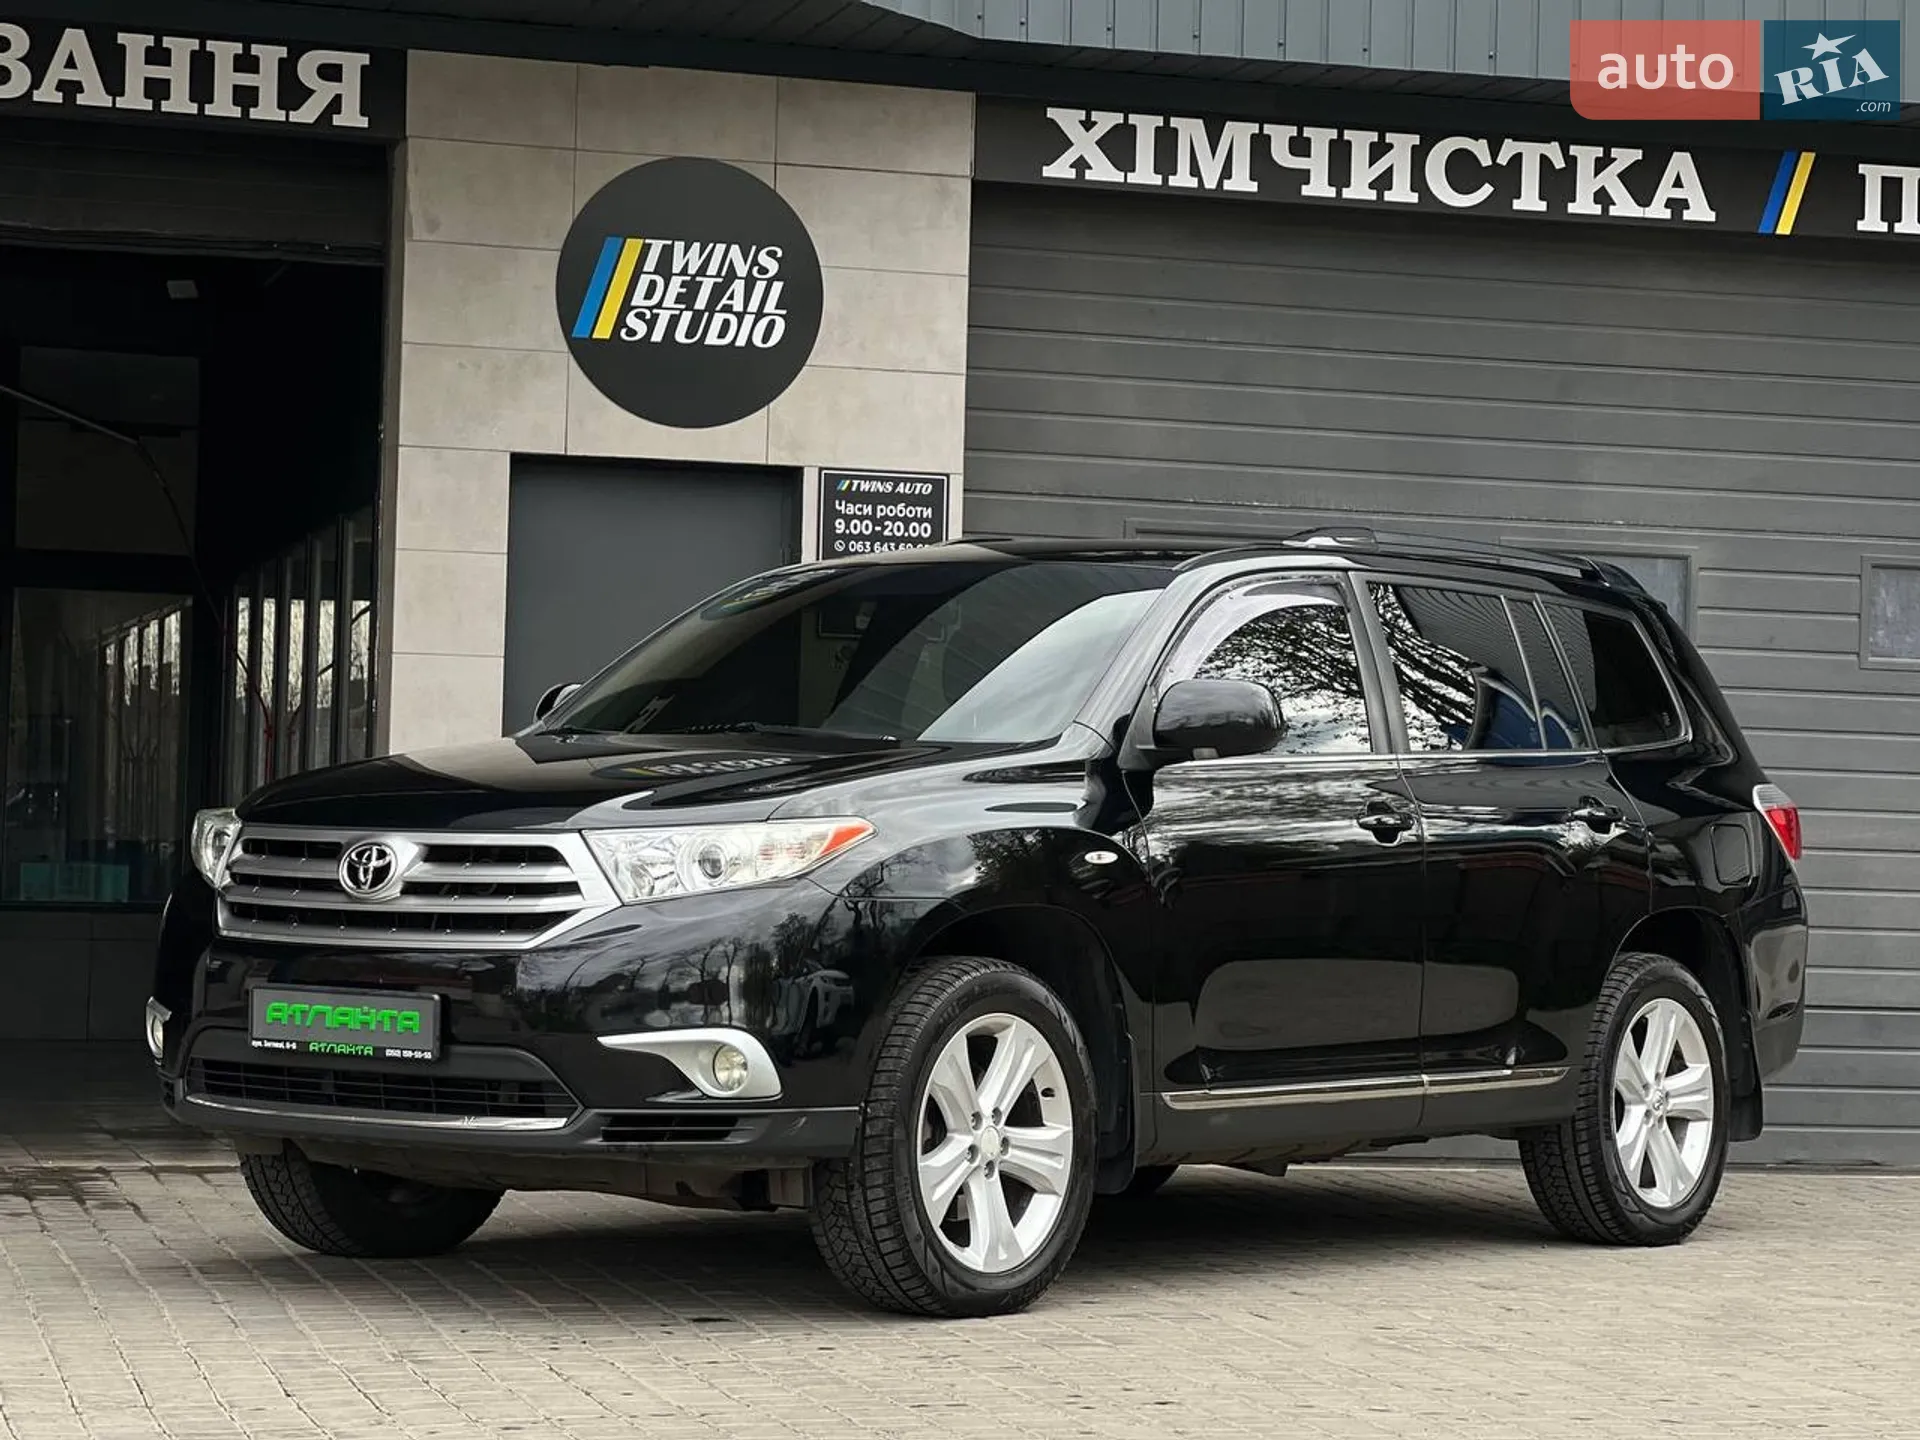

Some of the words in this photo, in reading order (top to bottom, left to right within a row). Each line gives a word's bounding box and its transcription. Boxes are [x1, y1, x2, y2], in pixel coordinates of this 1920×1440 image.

[1042, 107, 1716, 223] ХІМЧИСТКА
[643, 238, 783, 279] TWINS
[630, 275, 787, 315] DETAIL
[620, 309, 786, 348] STUDIO
[851, 480, 893, 493] TWINS
[895, 482, 933, 495] AUTO
[834, 499, 872, 516] Часи
[876, 502, 932, 519] роботи
[849, 541, 871, 553] 063
